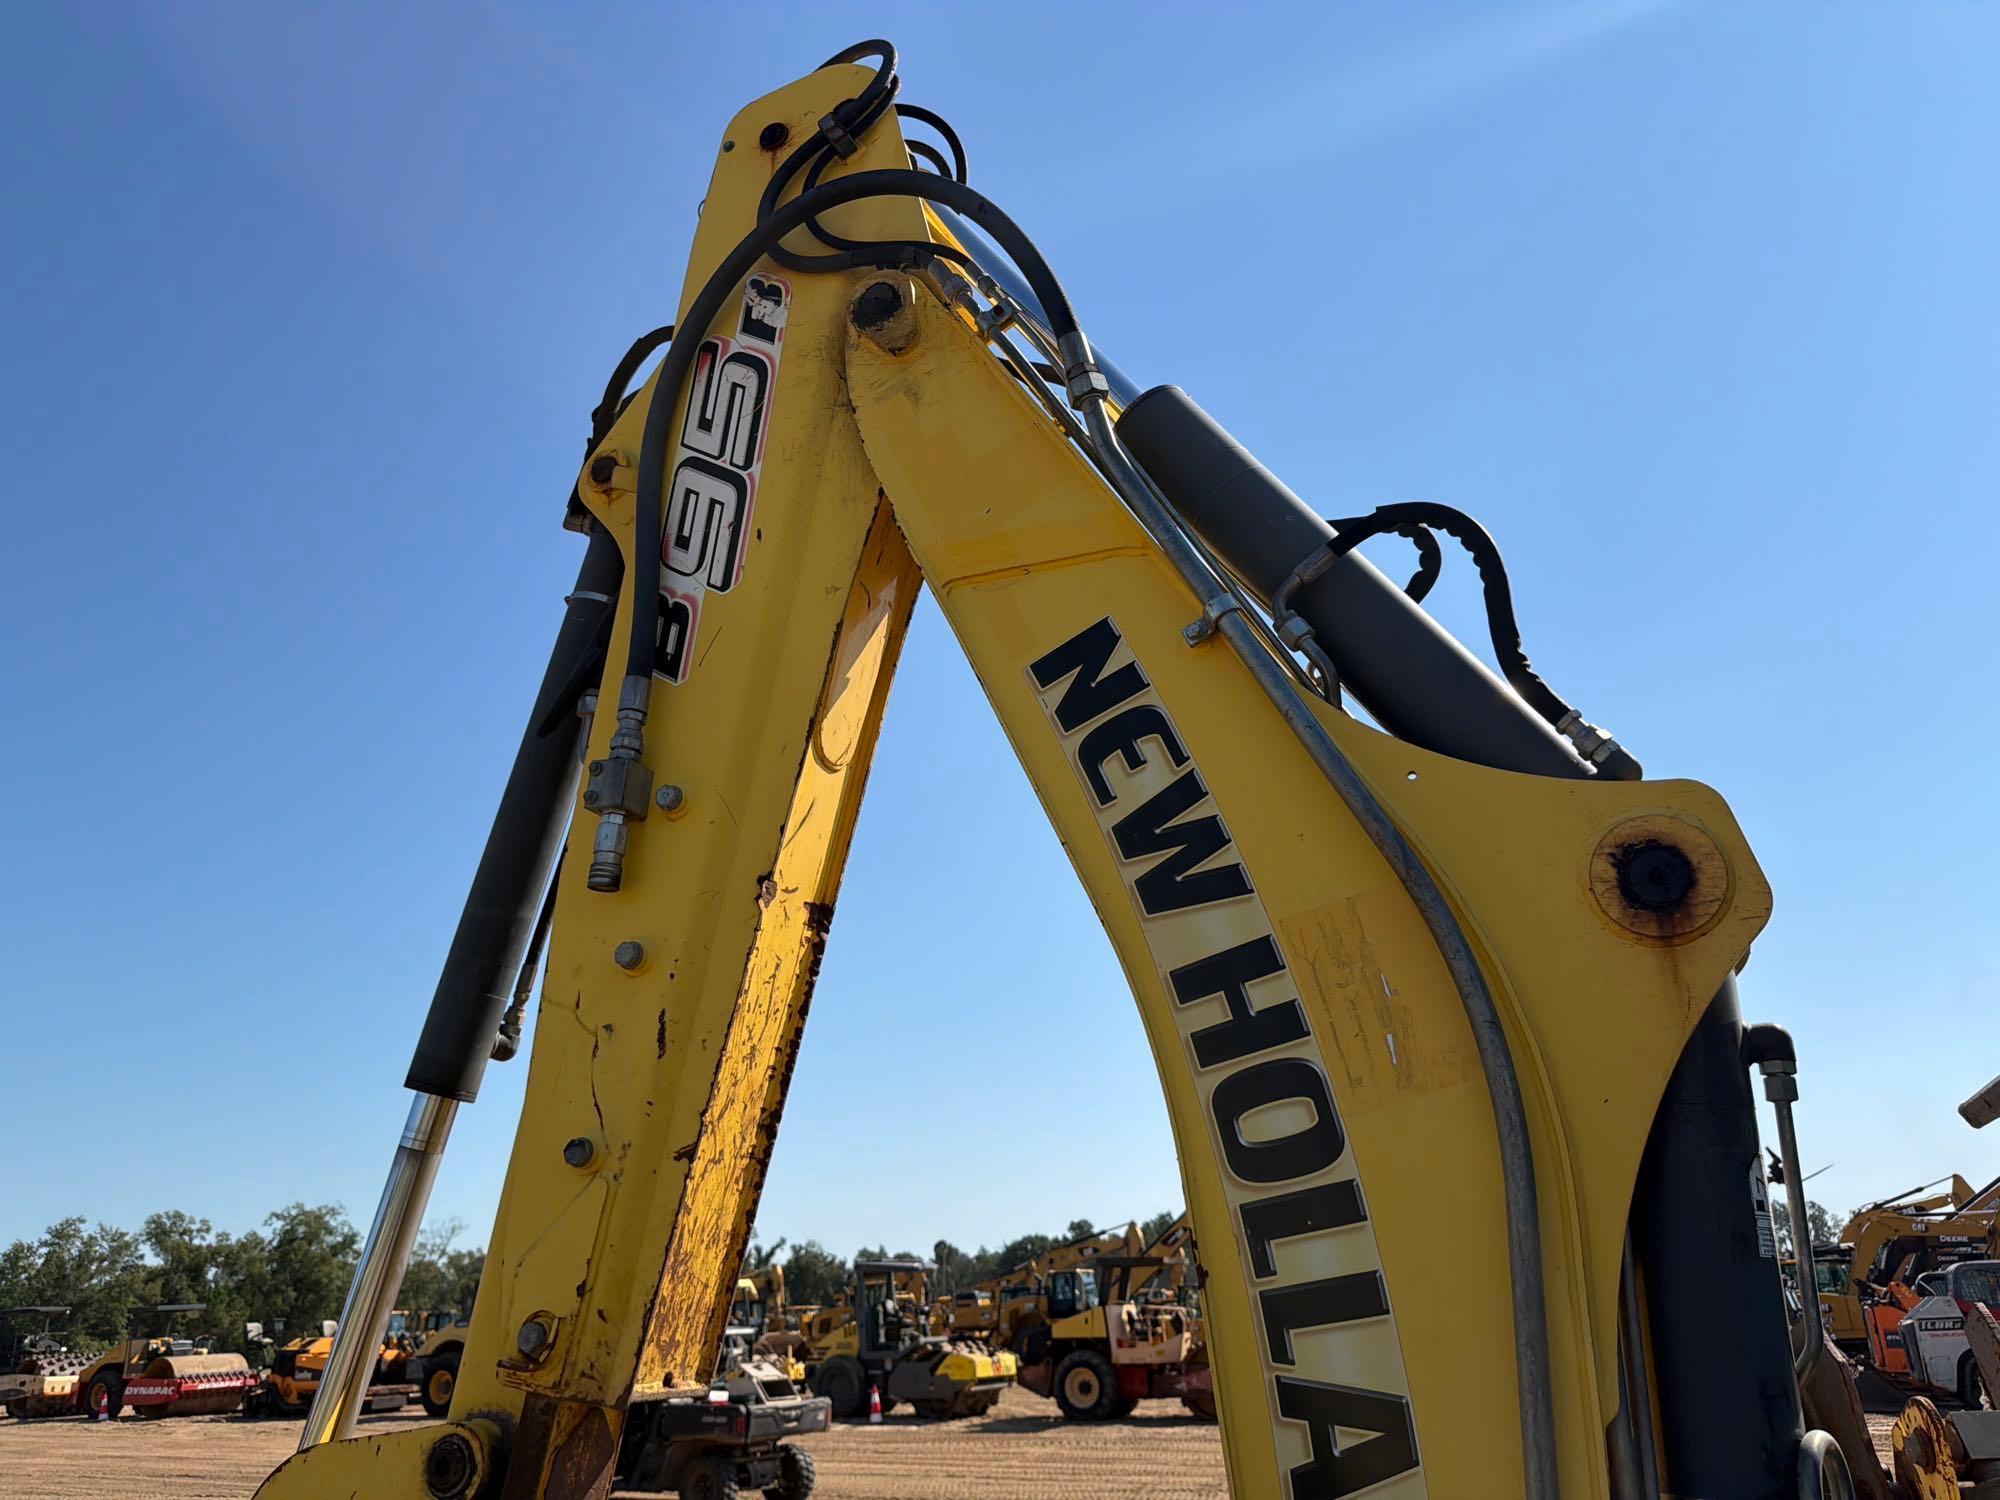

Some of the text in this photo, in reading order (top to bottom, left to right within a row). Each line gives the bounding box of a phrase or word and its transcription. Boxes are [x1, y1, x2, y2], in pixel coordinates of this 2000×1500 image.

[1029, 615, 1255, 915] NEW
[1939, 1234, 1969, 1243] DEERE
[125, 1386, 175, 1395] DYNAPAC
